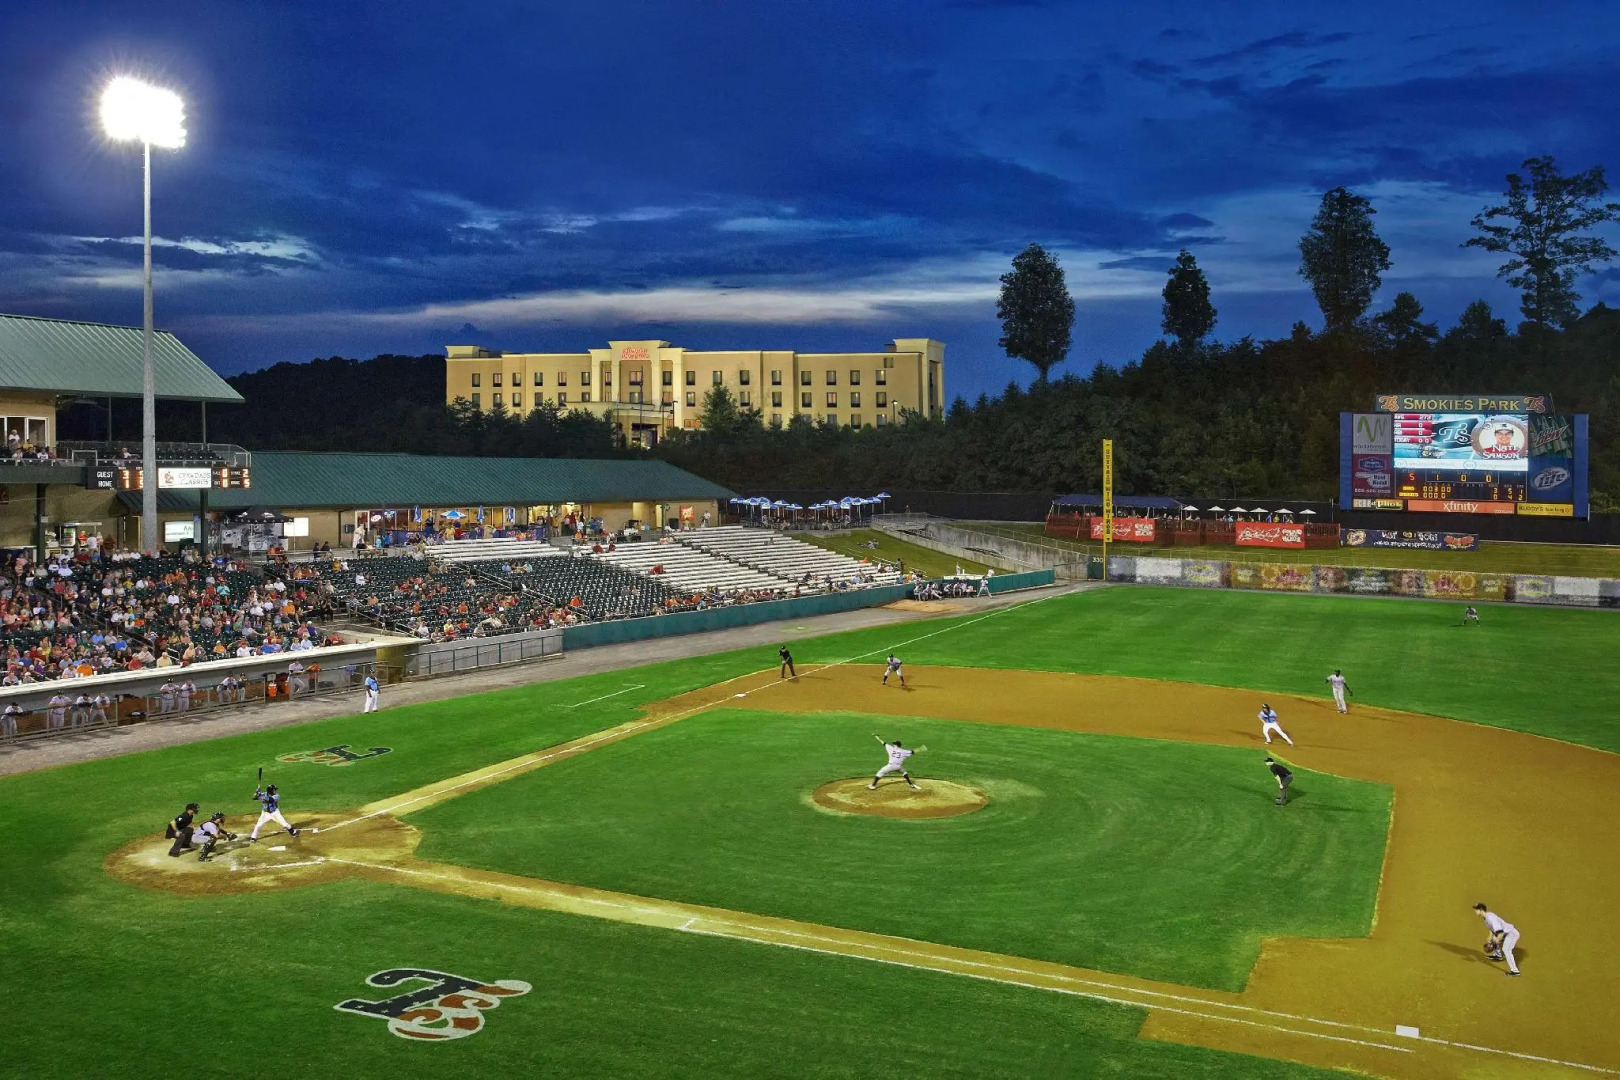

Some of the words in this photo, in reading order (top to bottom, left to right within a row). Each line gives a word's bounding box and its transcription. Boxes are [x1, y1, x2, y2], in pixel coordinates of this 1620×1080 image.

[1478, 398, 1520, 411] PARK
[122, 470, 130, 479] 3
[242, 468, 249, 478] 2
[1460, 474, 1467, 482] 0
[1485, 474, 1492, 483] 0
[1442, 501, 1479, 513] xfinity
[891, 750, 902, 759] 23
